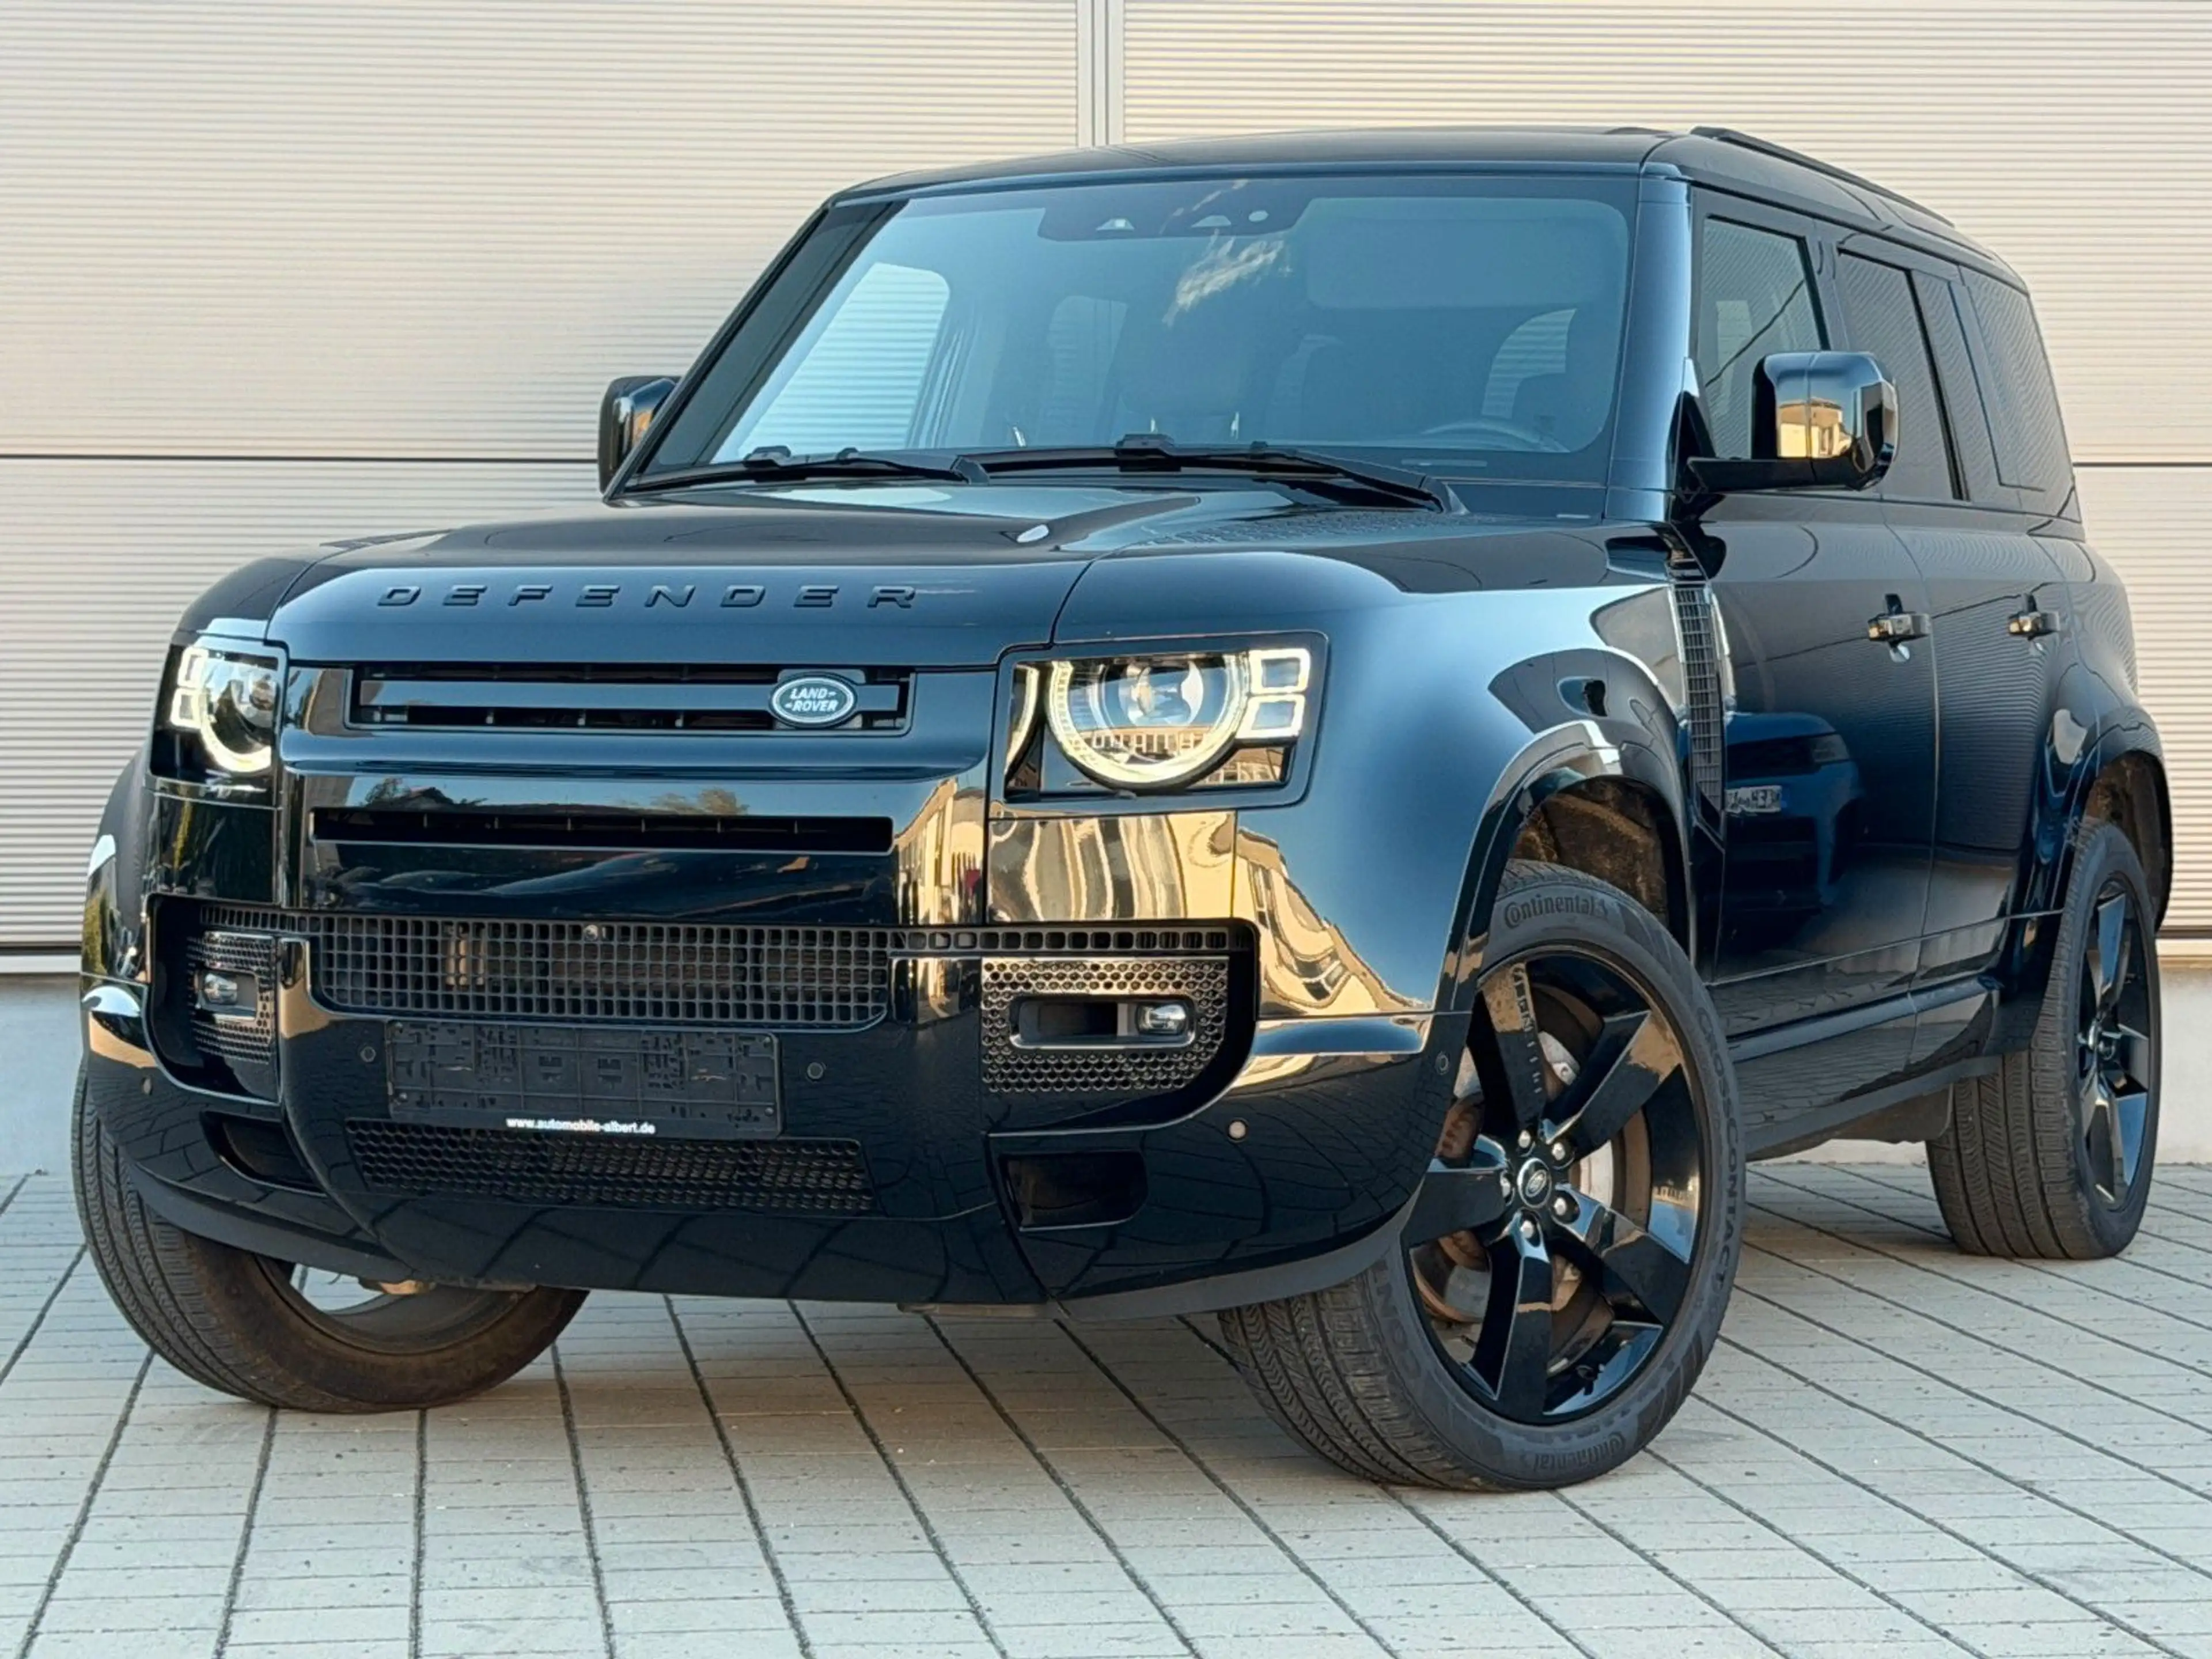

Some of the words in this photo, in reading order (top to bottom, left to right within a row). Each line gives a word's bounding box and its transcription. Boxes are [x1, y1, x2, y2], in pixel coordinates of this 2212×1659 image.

[377, 584, 916, 608] DEFENDER
[1504, 893, 1595, 929] Continental
[506, 1118, 656, 1134] www.automobile-albert.de
